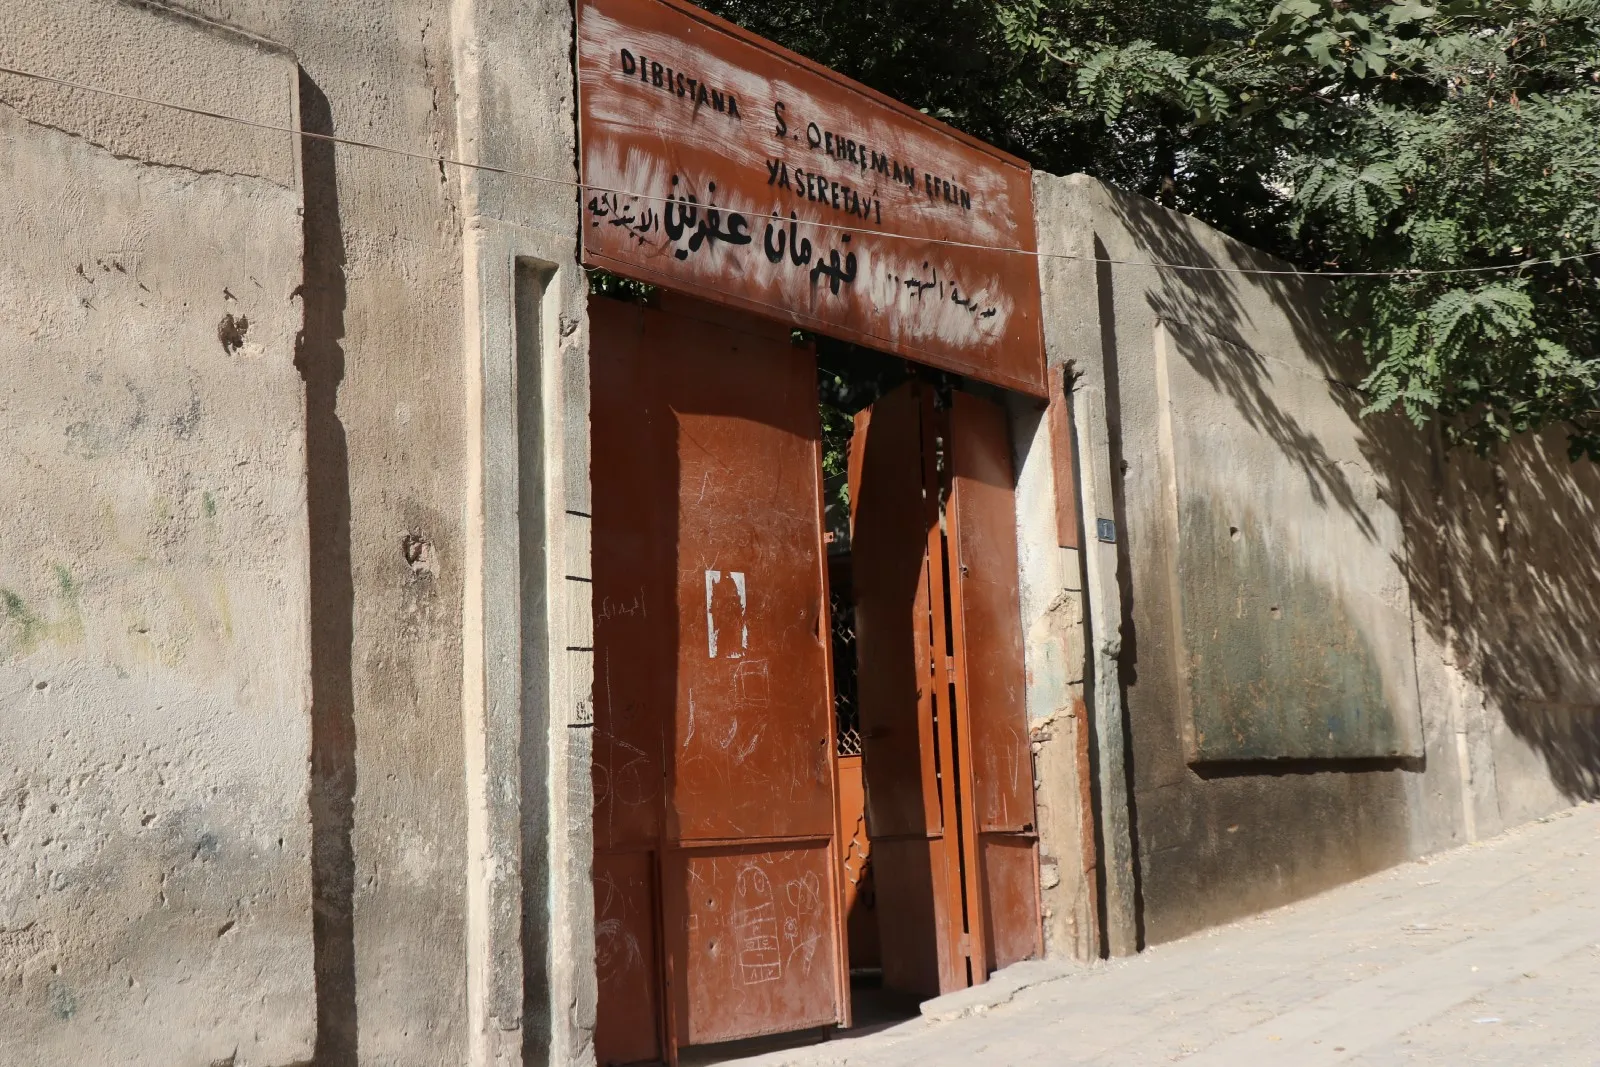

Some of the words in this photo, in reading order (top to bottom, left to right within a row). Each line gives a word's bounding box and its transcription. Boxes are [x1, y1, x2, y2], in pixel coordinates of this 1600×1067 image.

[620, 48, 742, 121] DIBISTANA
[664, 174, 752, 261] عفرين
[764, 210, 858, 296] قهرمان
